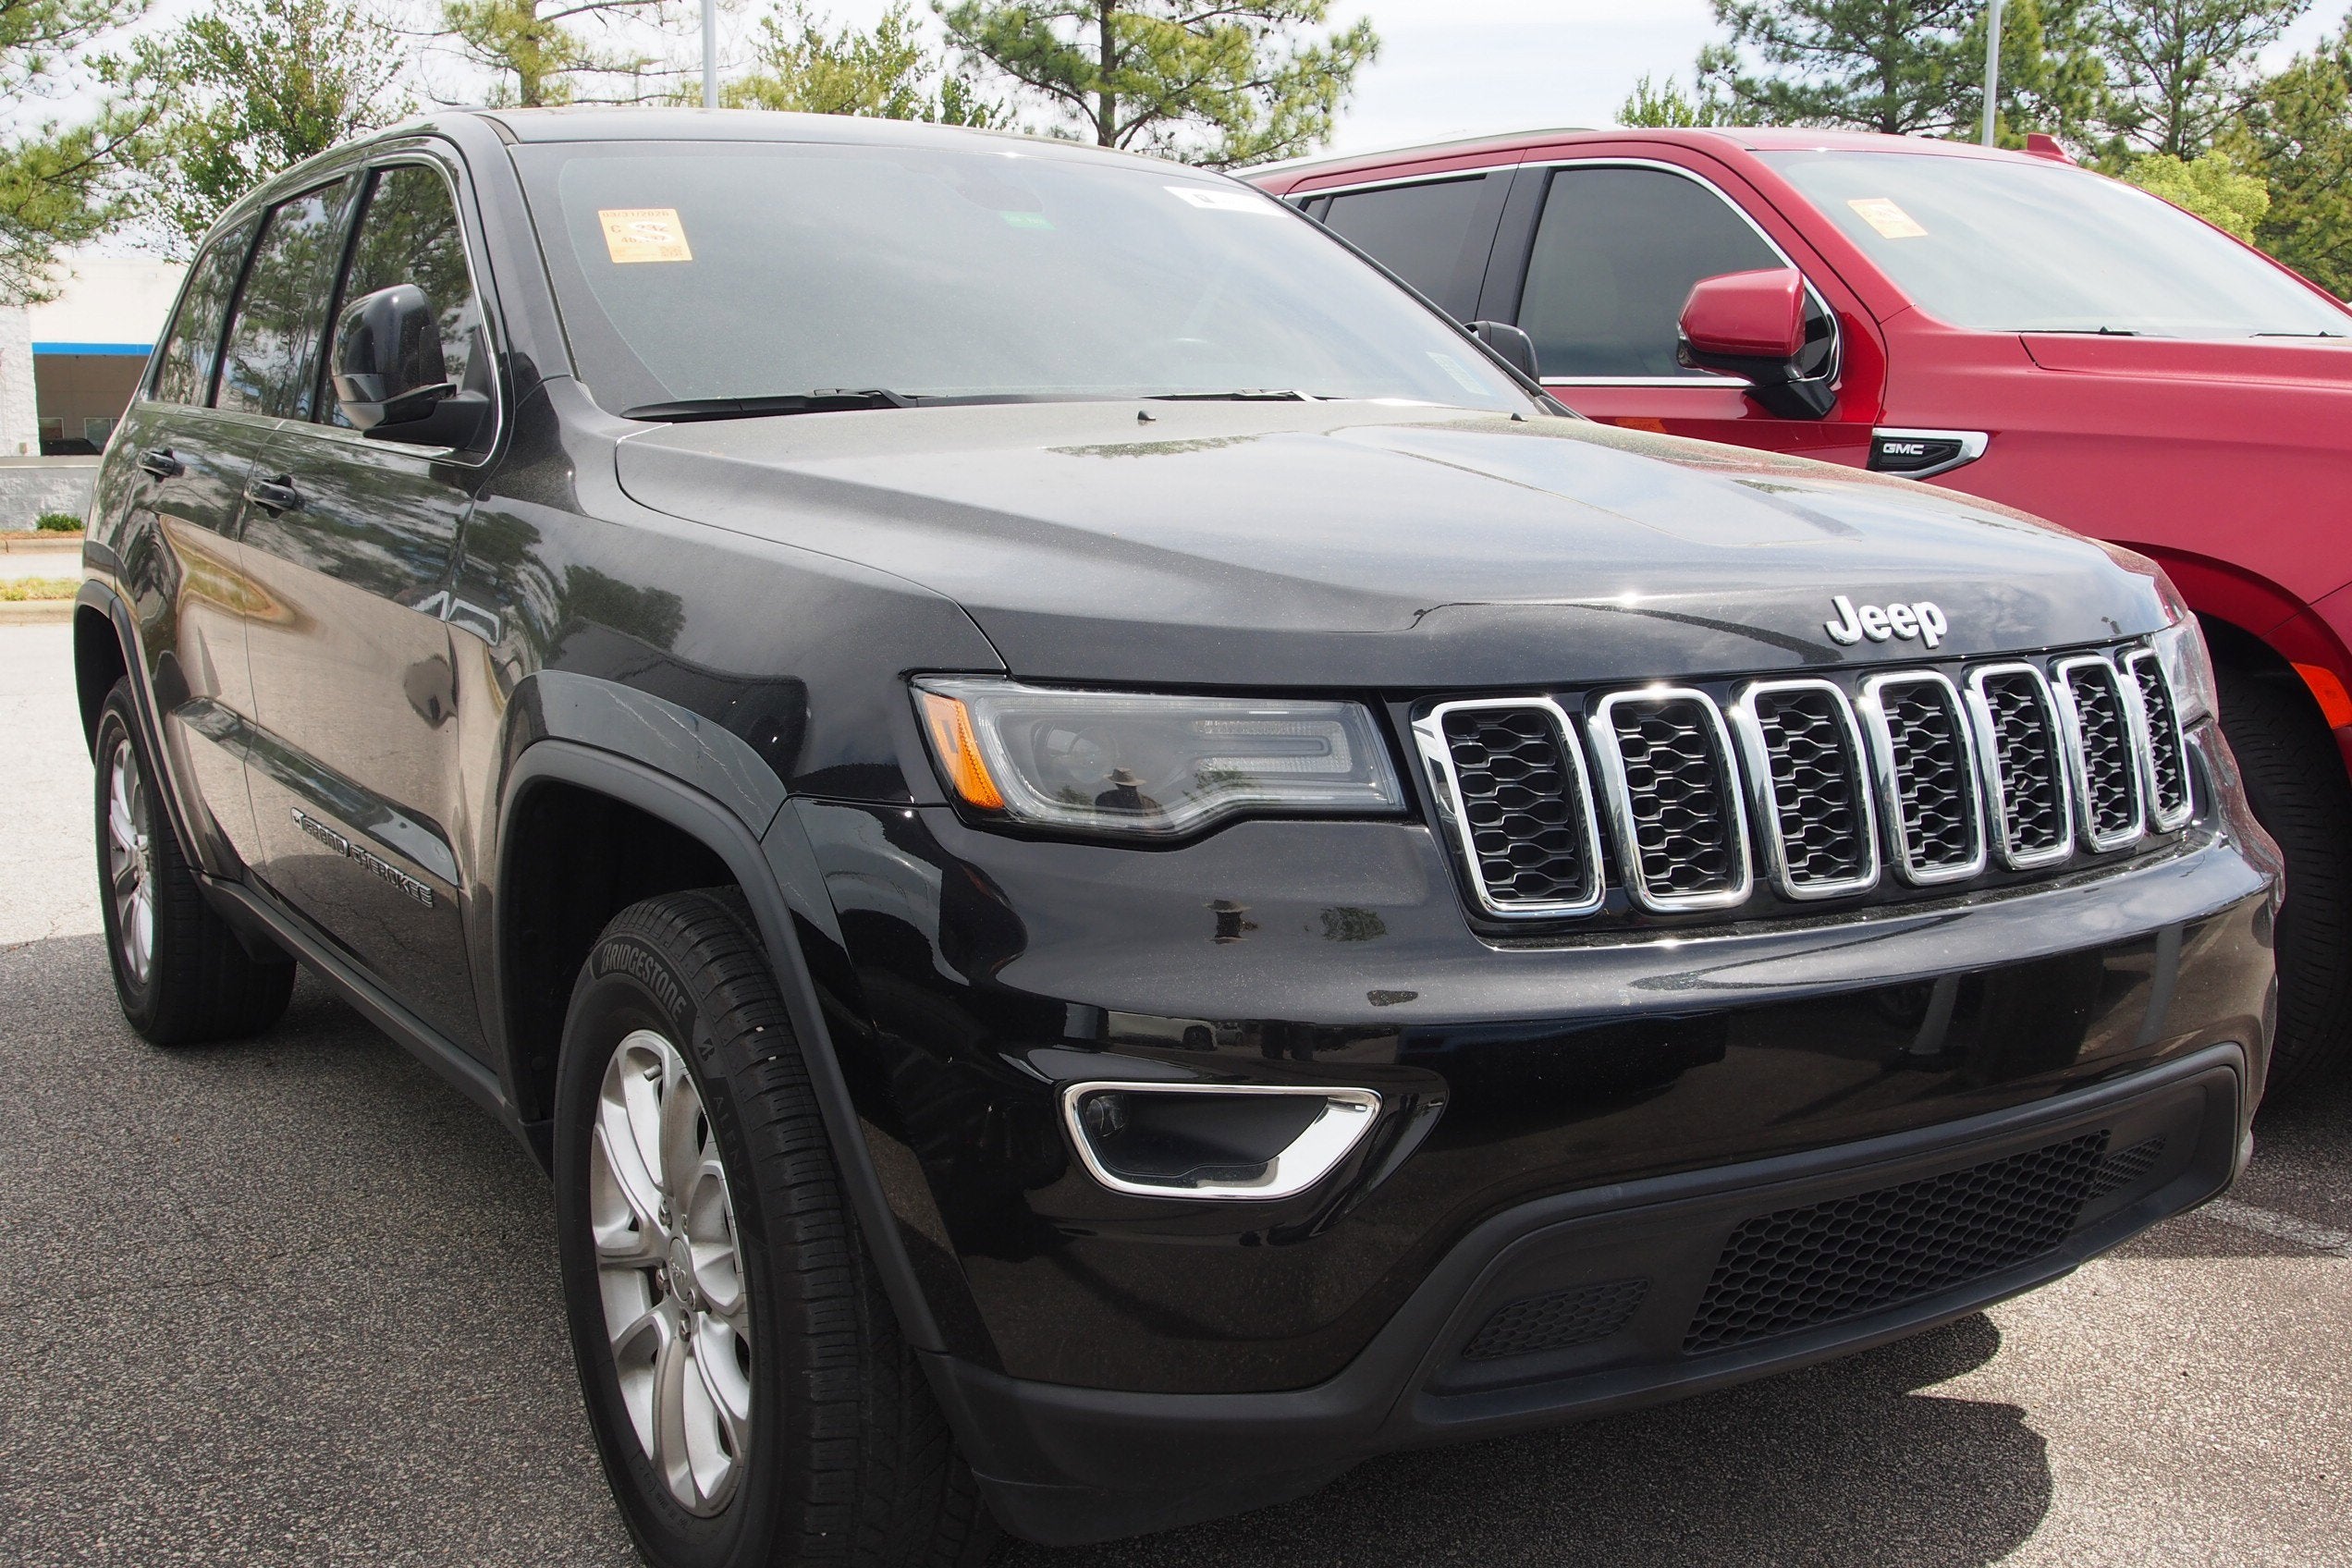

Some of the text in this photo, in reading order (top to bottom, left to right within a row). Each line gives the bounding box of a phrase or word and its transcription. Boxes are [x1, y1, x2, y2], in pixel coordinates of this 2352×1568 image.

[1882, 443, 1924, 455] GMC
[1824, 594, 1948, 649] Jeep
[300, 814, 434, 909] GRAND CHEROKEE
[601, 942, 687, 1023] BRIDGESTONE
